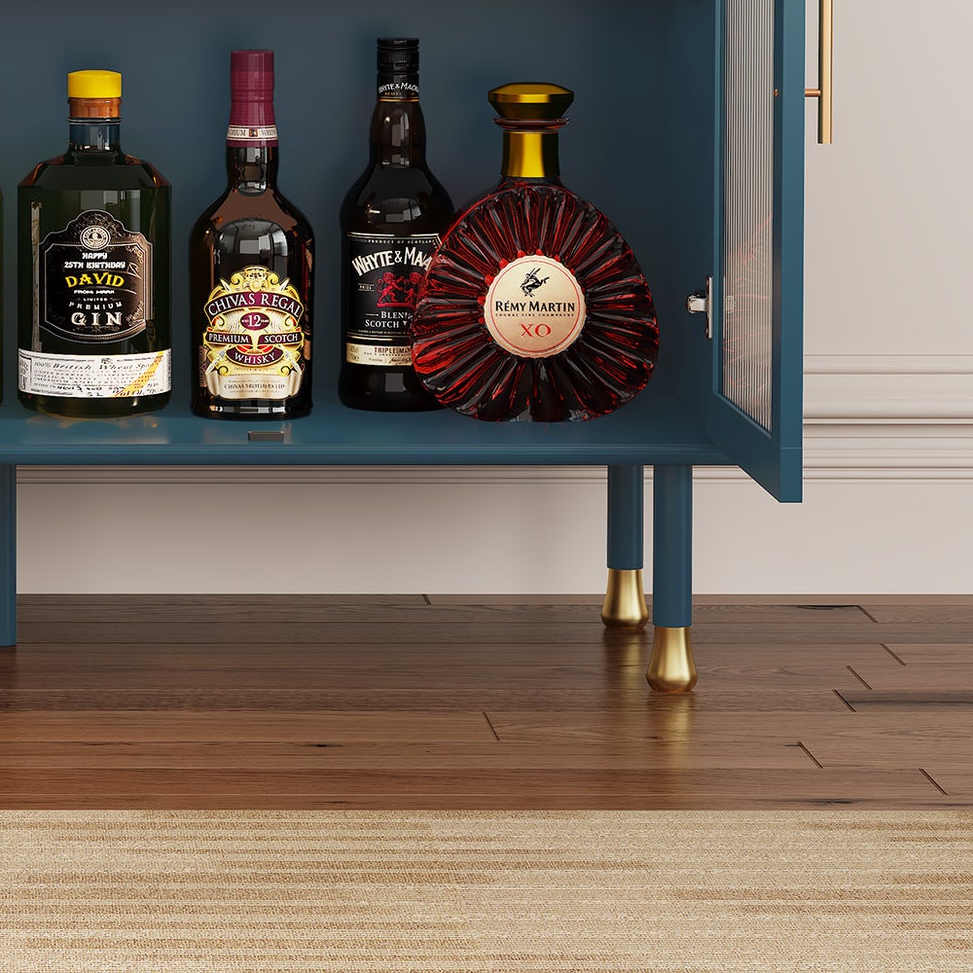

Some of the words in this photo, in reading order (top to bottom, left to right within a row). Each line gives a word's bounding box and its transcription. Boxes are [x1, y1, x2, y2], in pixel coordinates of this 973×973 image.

[81, 252, 108, 260] HAPPY
[64, 261, 84, 269] 25TH
[86, 261, 126, 269] BIRTHDAY
[351, 250, 395, 277] WHYTE
[394, 250, 403, 263] &
[64, 271, 125, 288] DAVID
[68, 301, 123, 310] PREMIUM
[208, 292, 256, 316] CHIVAS
[260, 293, 302, 318] REGAL
[495, 300, 527, 312] RÉMY
[528, 300, 575, 312] MARTIN
[70, 311, 124, 326] GIN
[247, 314, 262, 327] 12
[365, 319, 400, 328] SCOTCH
[519, 323, 552, 338] XO
[208, 333, 249, 343] PREMIUM
[264, 333, 298, 343] SCOTCH
[233, 352, 276, 365] WHISKY
